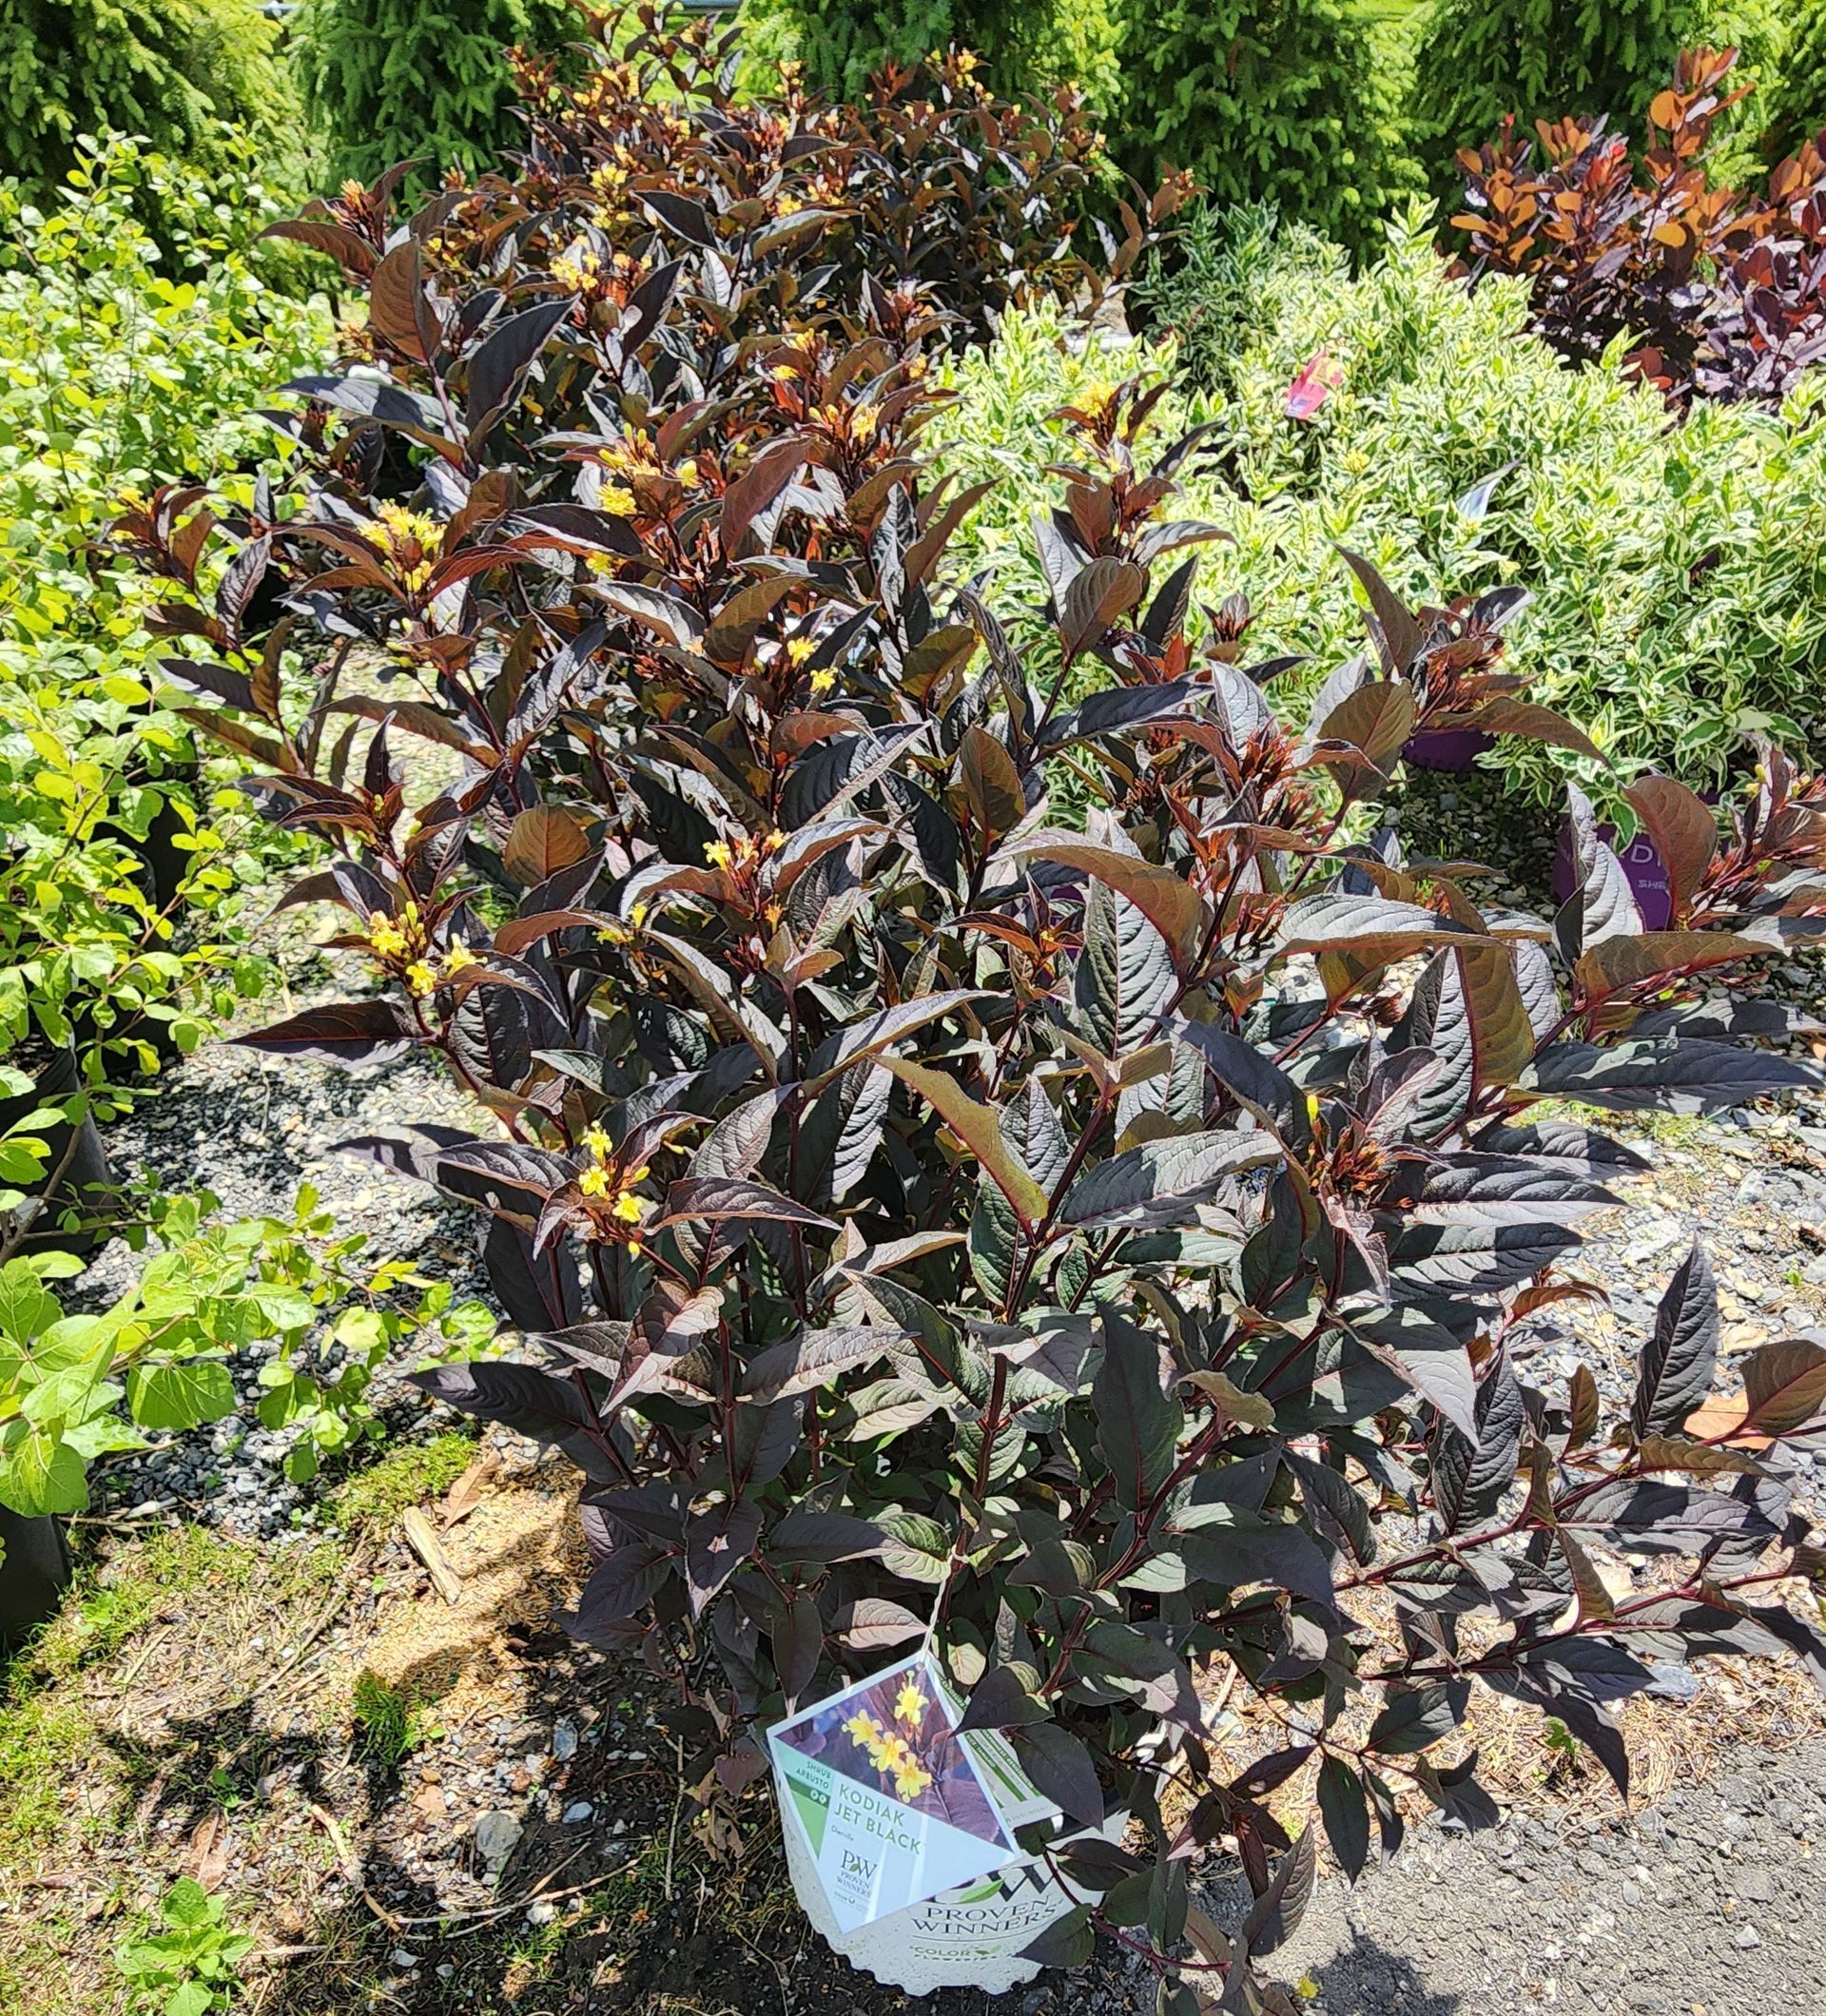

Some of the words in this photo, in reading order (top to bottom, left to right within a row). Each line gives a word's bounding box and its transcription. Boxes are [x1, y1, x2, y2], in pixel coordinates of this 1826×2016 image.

[796, 1767, 829, 1790] ARBUSTO
[806, 1761, 832, 1779] SHRUB
[839, 1783, 905, 1827] KODIAK
[834, 1802, 862, 1825] JET
[865, 1817, 921, 1854] BLACK
[837, 1875, 872, 1898] WINNERS
[841, 1871, 870, 1889] PROVEN
[911, 1902, 1058, 1934] WINNERS
[926, 1894, 1051, 1922] PROVEN
[915, 1946, 972, 1957] COLOR
